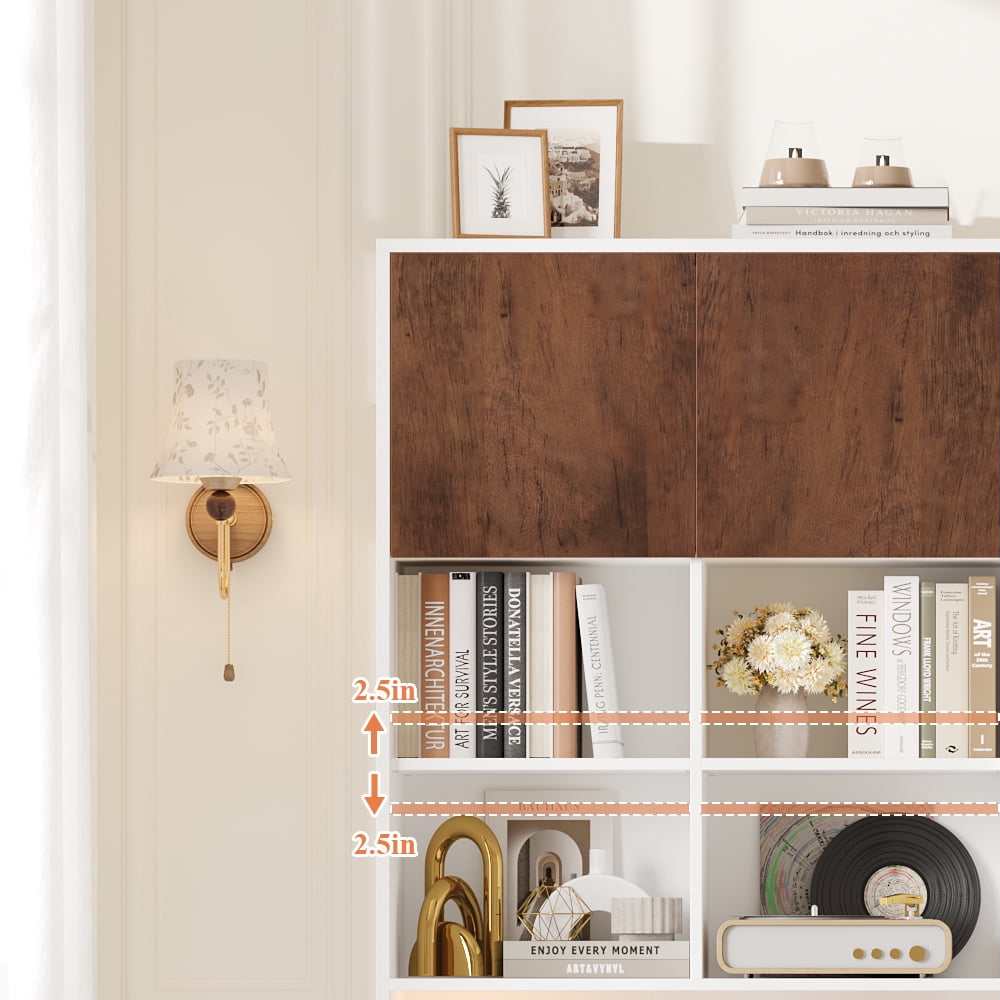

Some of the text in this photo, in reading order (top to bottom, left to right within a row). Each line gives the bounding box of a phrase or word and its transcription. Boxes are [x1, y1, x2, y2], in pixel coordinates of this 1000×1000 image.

[795, 229, 833, 237] Handbok
[840, 229, 882, 238] inredning
[884, 229, 900, 237] och
[902, 229, 931, 238] styling
[796, 208, 914, 217] VICTORIA HAGAN
[856, 614, 877, 659] FINE
[892, 582, 912, 656] WINDOWS
[973, 618, 992, 649] ART
[425, 601, 445, 750] INNENARCHITEKTUR
[483, 585, 498, 741] MEN'S STYLE STORIES
[508, 587, 521, 746] DONATELLA VERSACE
[454, 649, 470, 749] ART FOR SURVIVAL
[856, 668, 877, 736] WINES
[530, 945, 661, 955] ENJOY EVERY MOMENT
